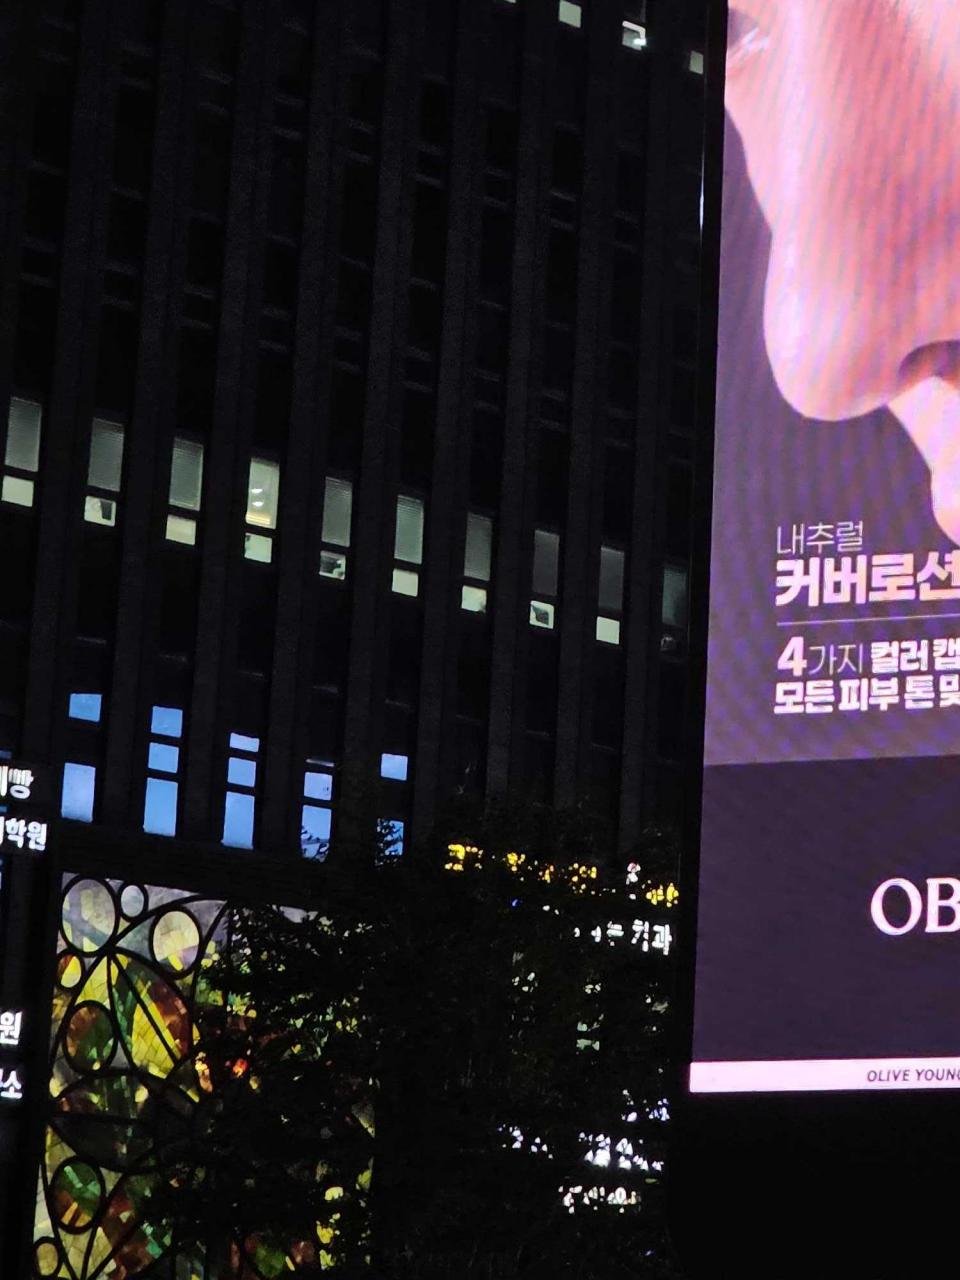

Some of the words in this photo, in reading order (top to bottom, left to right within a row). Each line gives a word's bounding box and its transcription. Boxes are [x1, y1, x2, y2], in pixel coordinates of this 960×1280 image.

[777, 521, 863, 555] 내추럴
[777, 636, 863, 677] 4가지
[871, 639, 928, 673] 컬러
[774, 679, 835, 714] 모든
[838, 677, 900, 712] 피부
[904, 675, 935, 709] 톤
[0, 816, 48, 851] 학원
[867, 1069, 910, 1082] OLIVE
